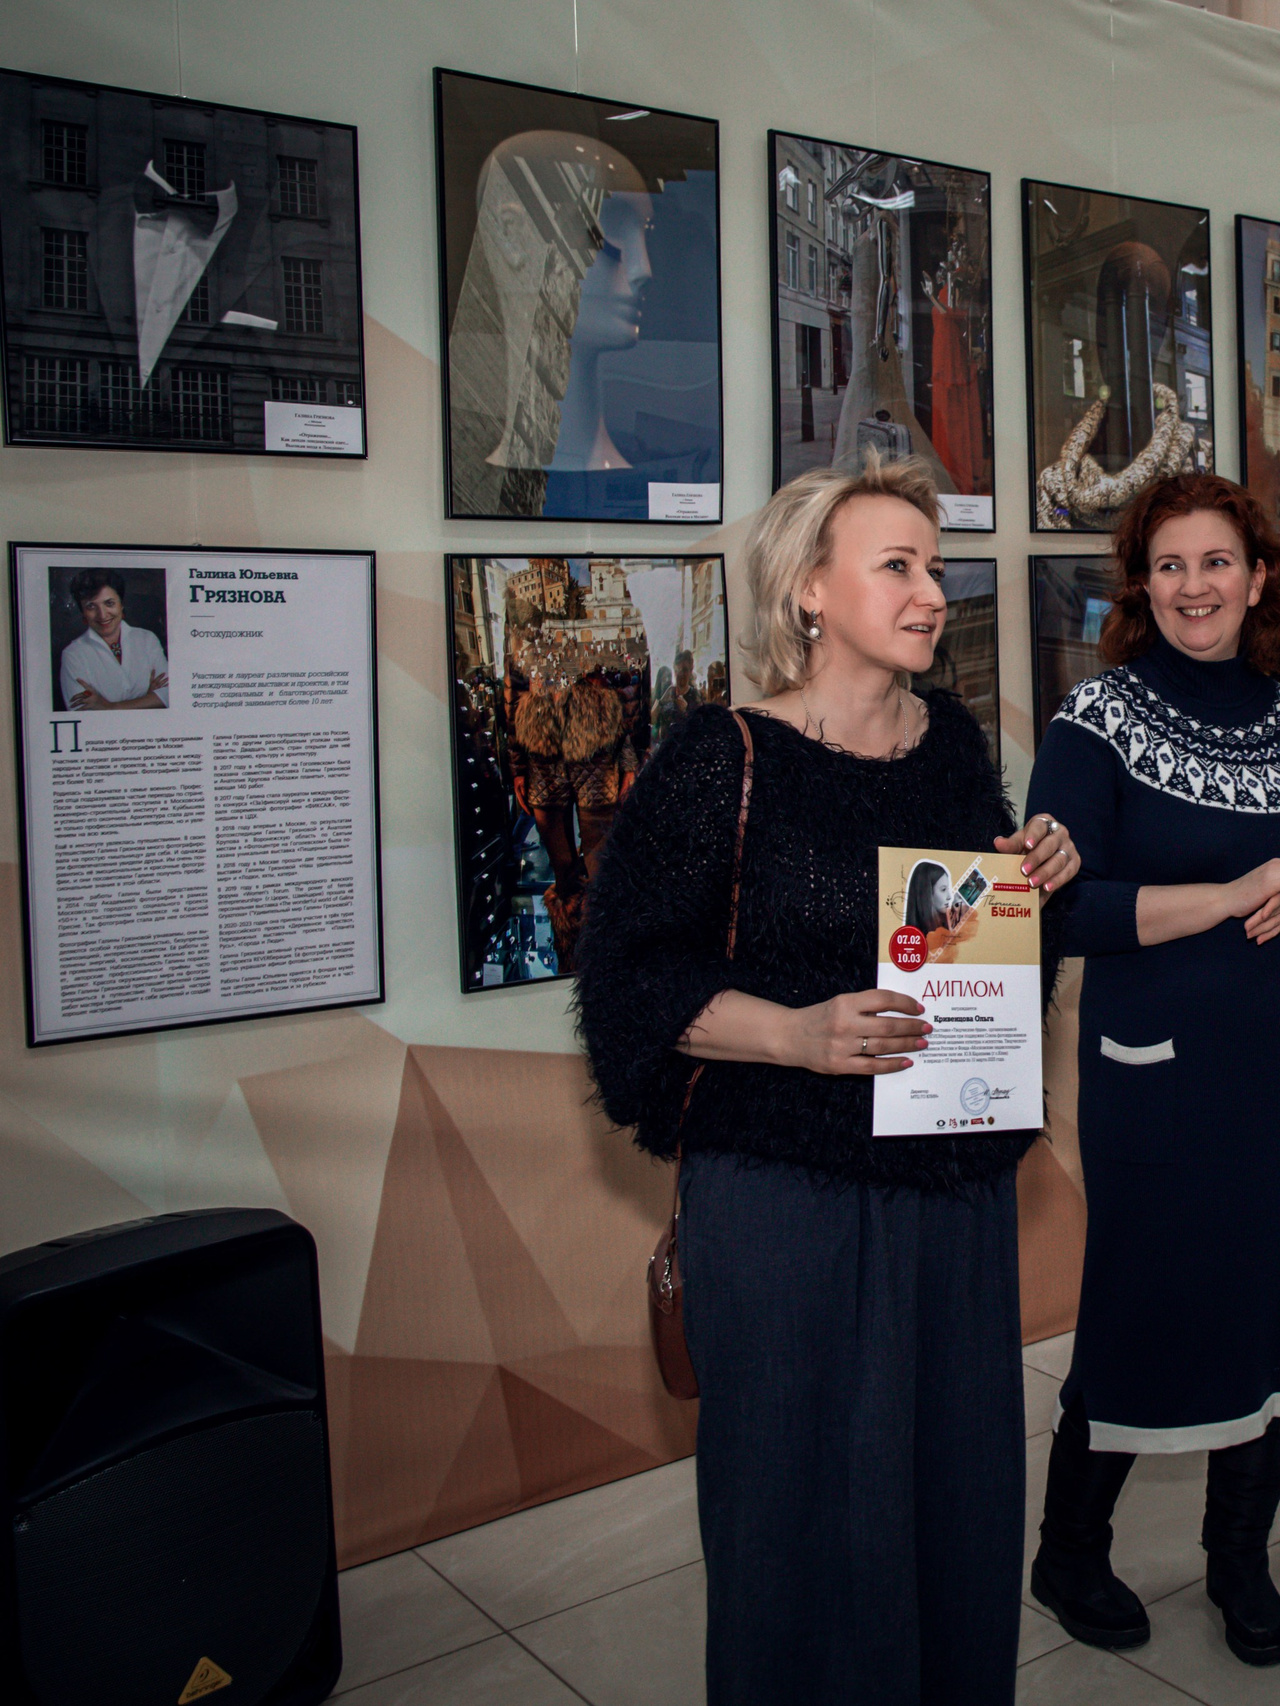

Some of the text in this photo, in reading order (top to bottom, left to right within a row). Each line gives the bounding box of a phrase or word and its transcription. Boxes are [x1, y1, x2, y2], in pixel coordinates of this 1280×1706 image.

[189, 568, 299, 580] Галина Юльевна
[190, 629, 263, 639] Фотохудожник
[992, 907, 1031, 918] БУДНИ
[897, 935, 920, 944] 07.02
[898, 953, 921, 963] 10.03
[922, 980, 1004, 1001] ДИПЛОМ
